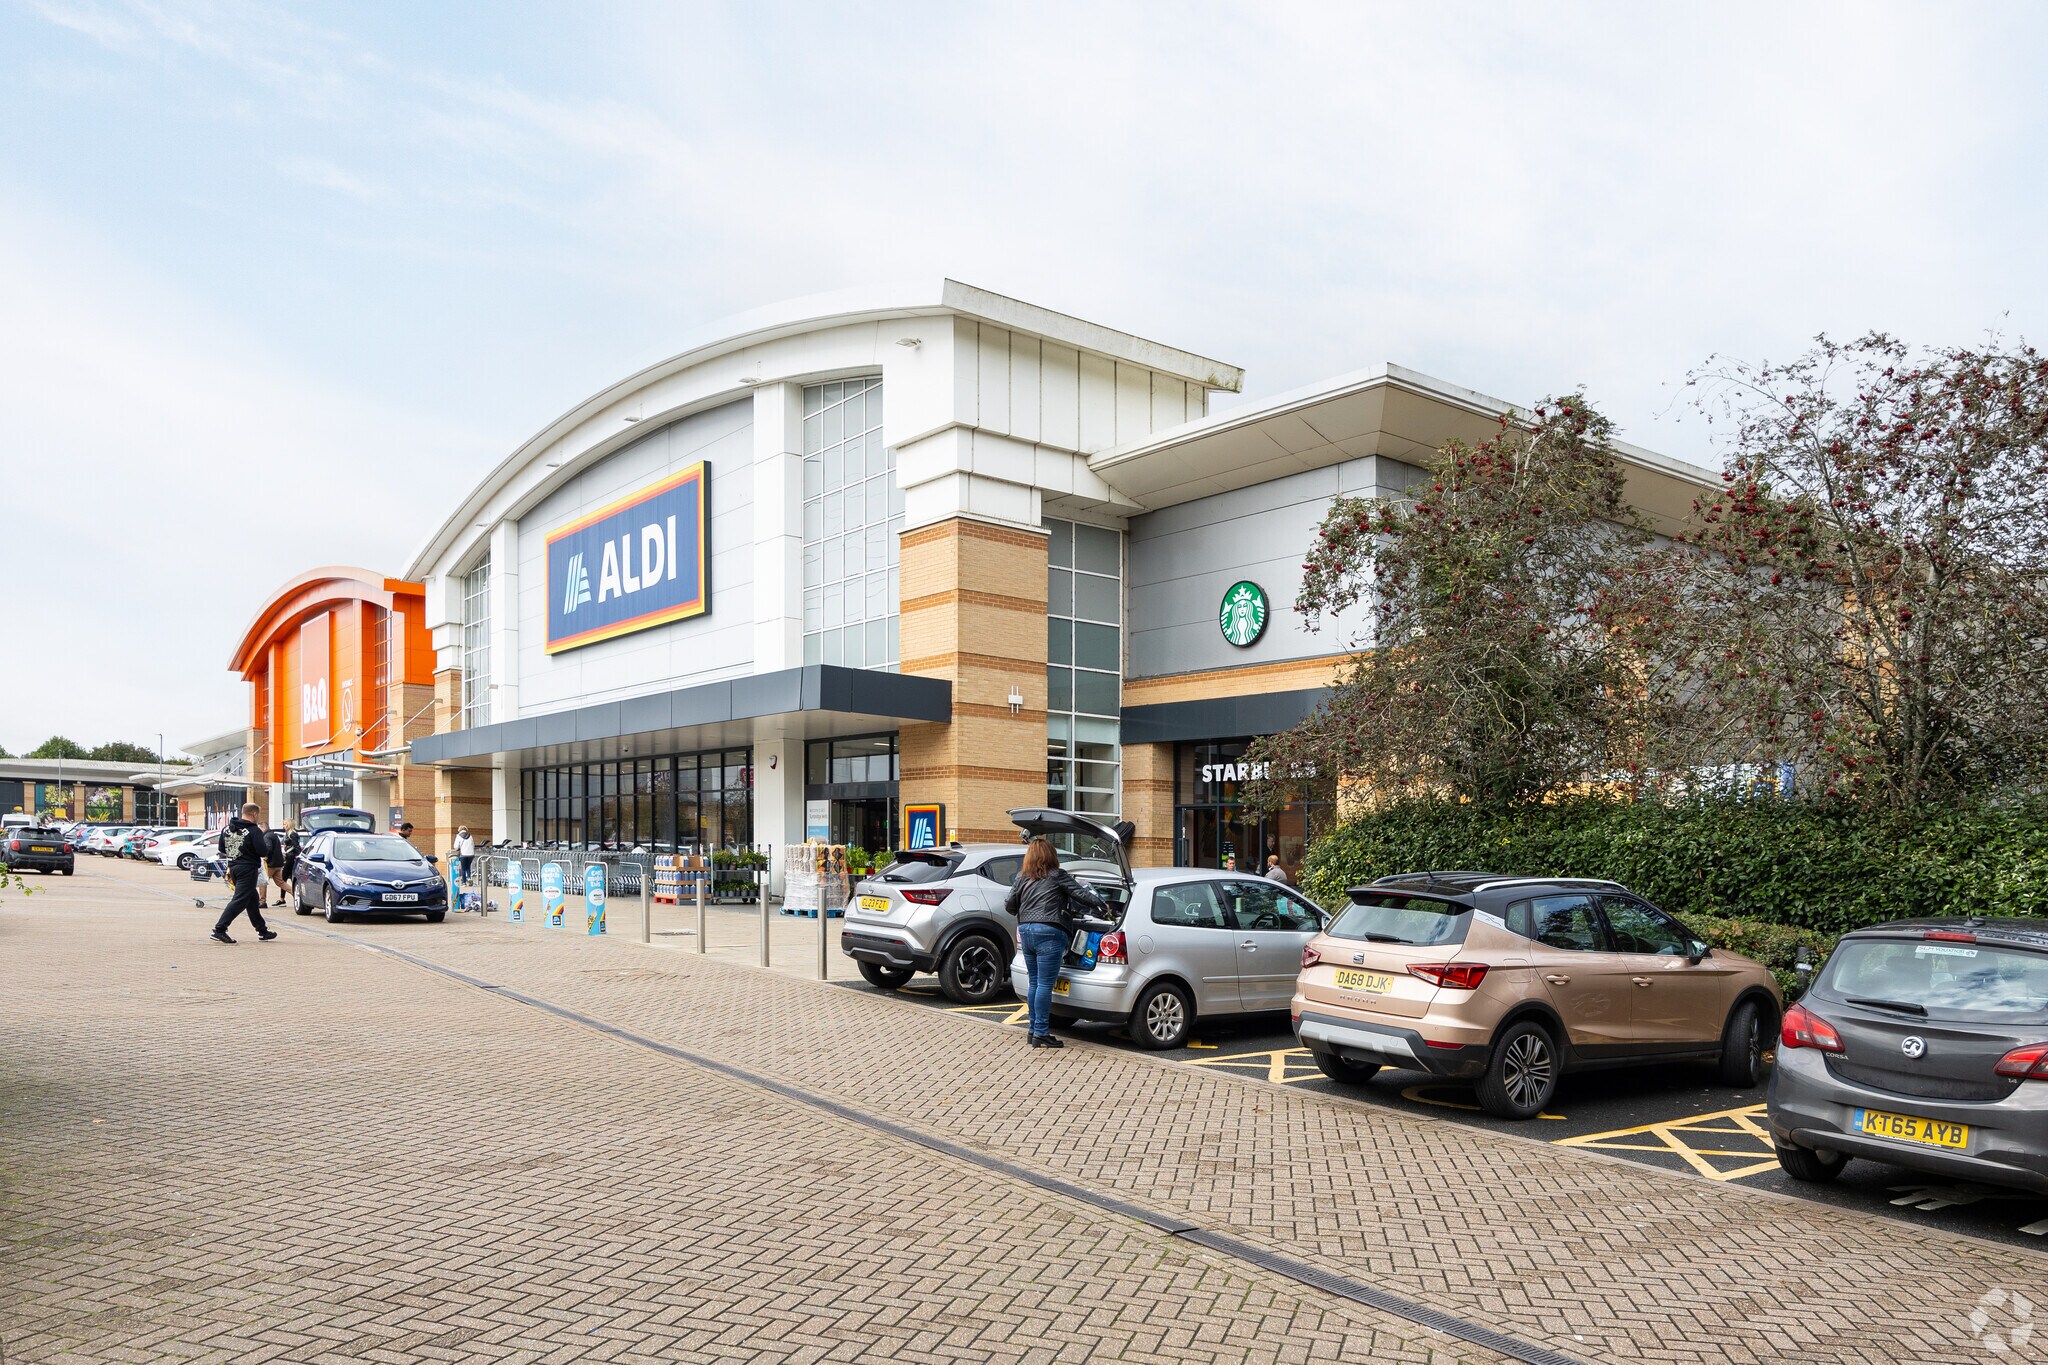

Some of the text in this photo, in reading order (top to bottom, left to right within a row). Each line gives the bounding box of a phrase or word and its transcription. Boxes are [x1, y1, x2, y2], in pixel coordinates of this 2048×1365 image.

[598, 514, 676, 604] ALDI
[303, 677, 327, 724] B&Q
[875, 899, 887, 909] FZT
[1338, 971, 1365, 986] DA68
[1366, 975, 1389, 990] DJK
[1825, 1052, 1849, 1060] CORSA
[1865, 1112, 1917, 1137] KT65
[1922, 1122, 1963, 1144] AYB
